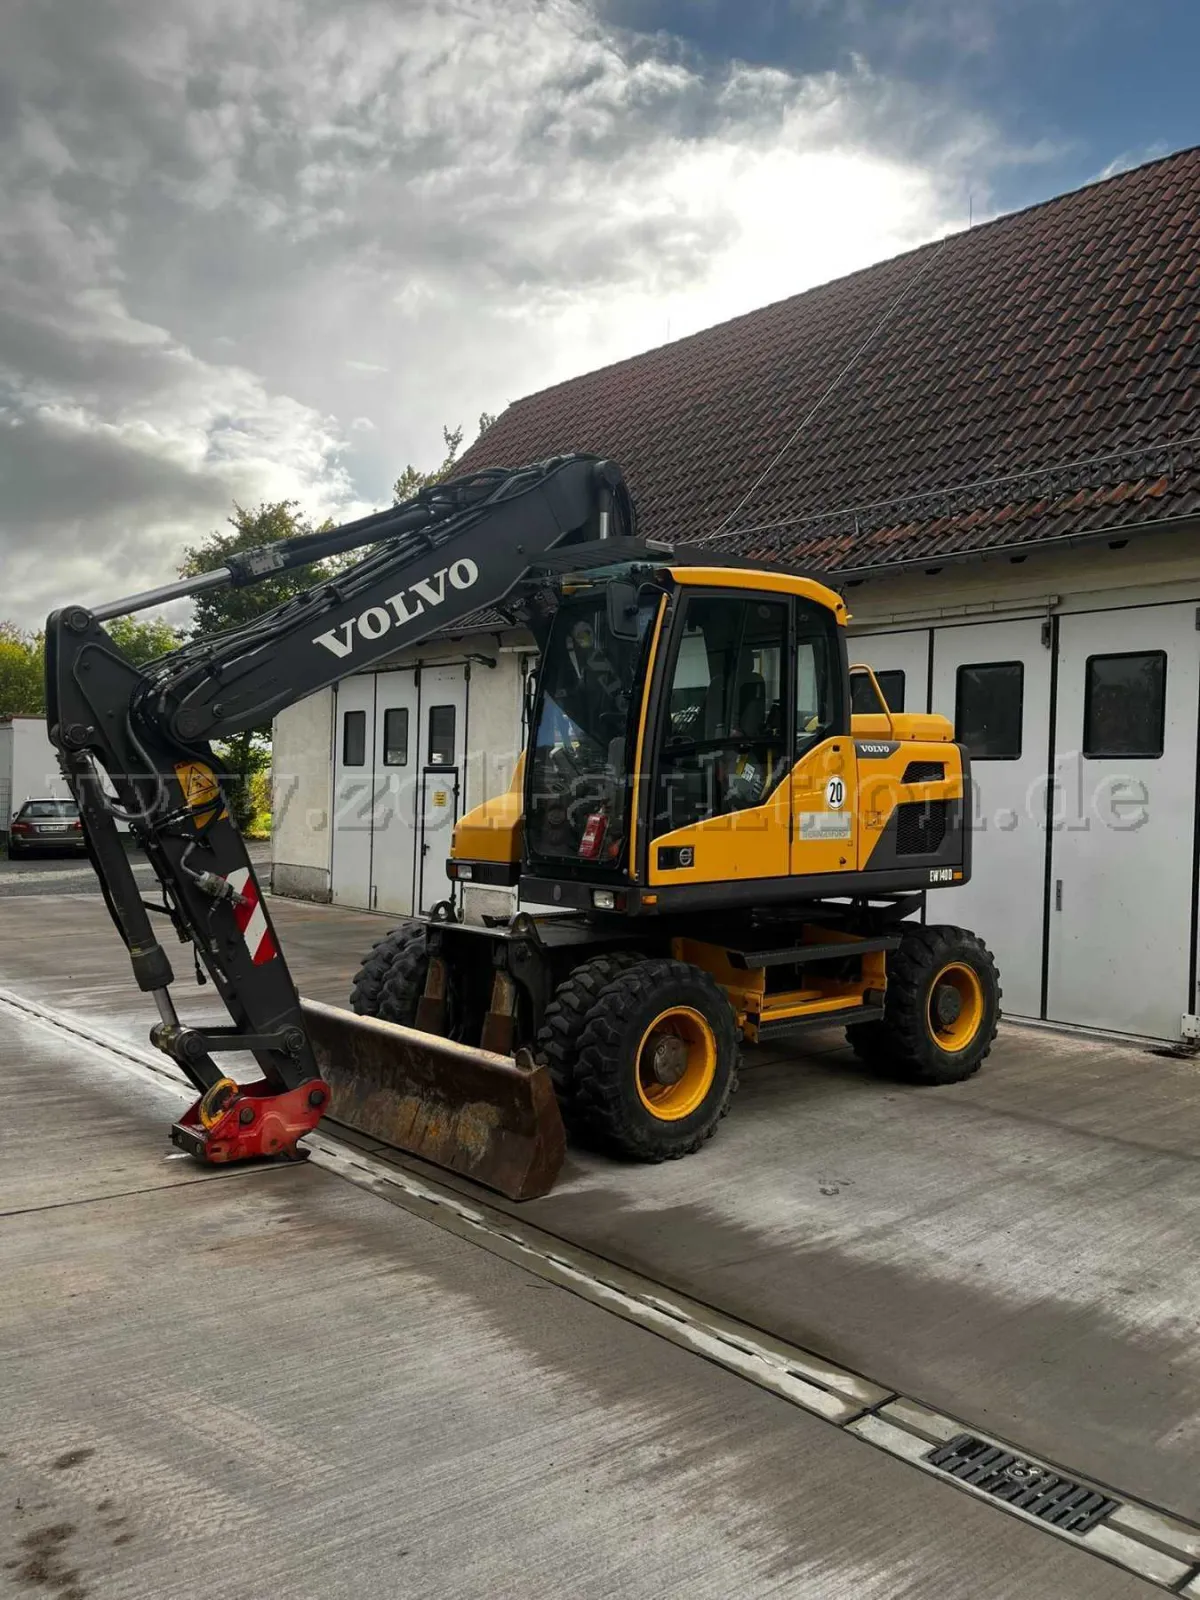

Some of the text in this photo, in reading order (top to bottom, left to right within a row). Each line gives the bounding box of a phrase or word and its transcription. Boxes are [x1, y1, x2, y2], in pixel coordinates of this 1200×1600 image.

[312, 558, 478, 658] VOLVO
[860, 744, 890, 753] VOLVO
[829, 782, 843, 803] 20
